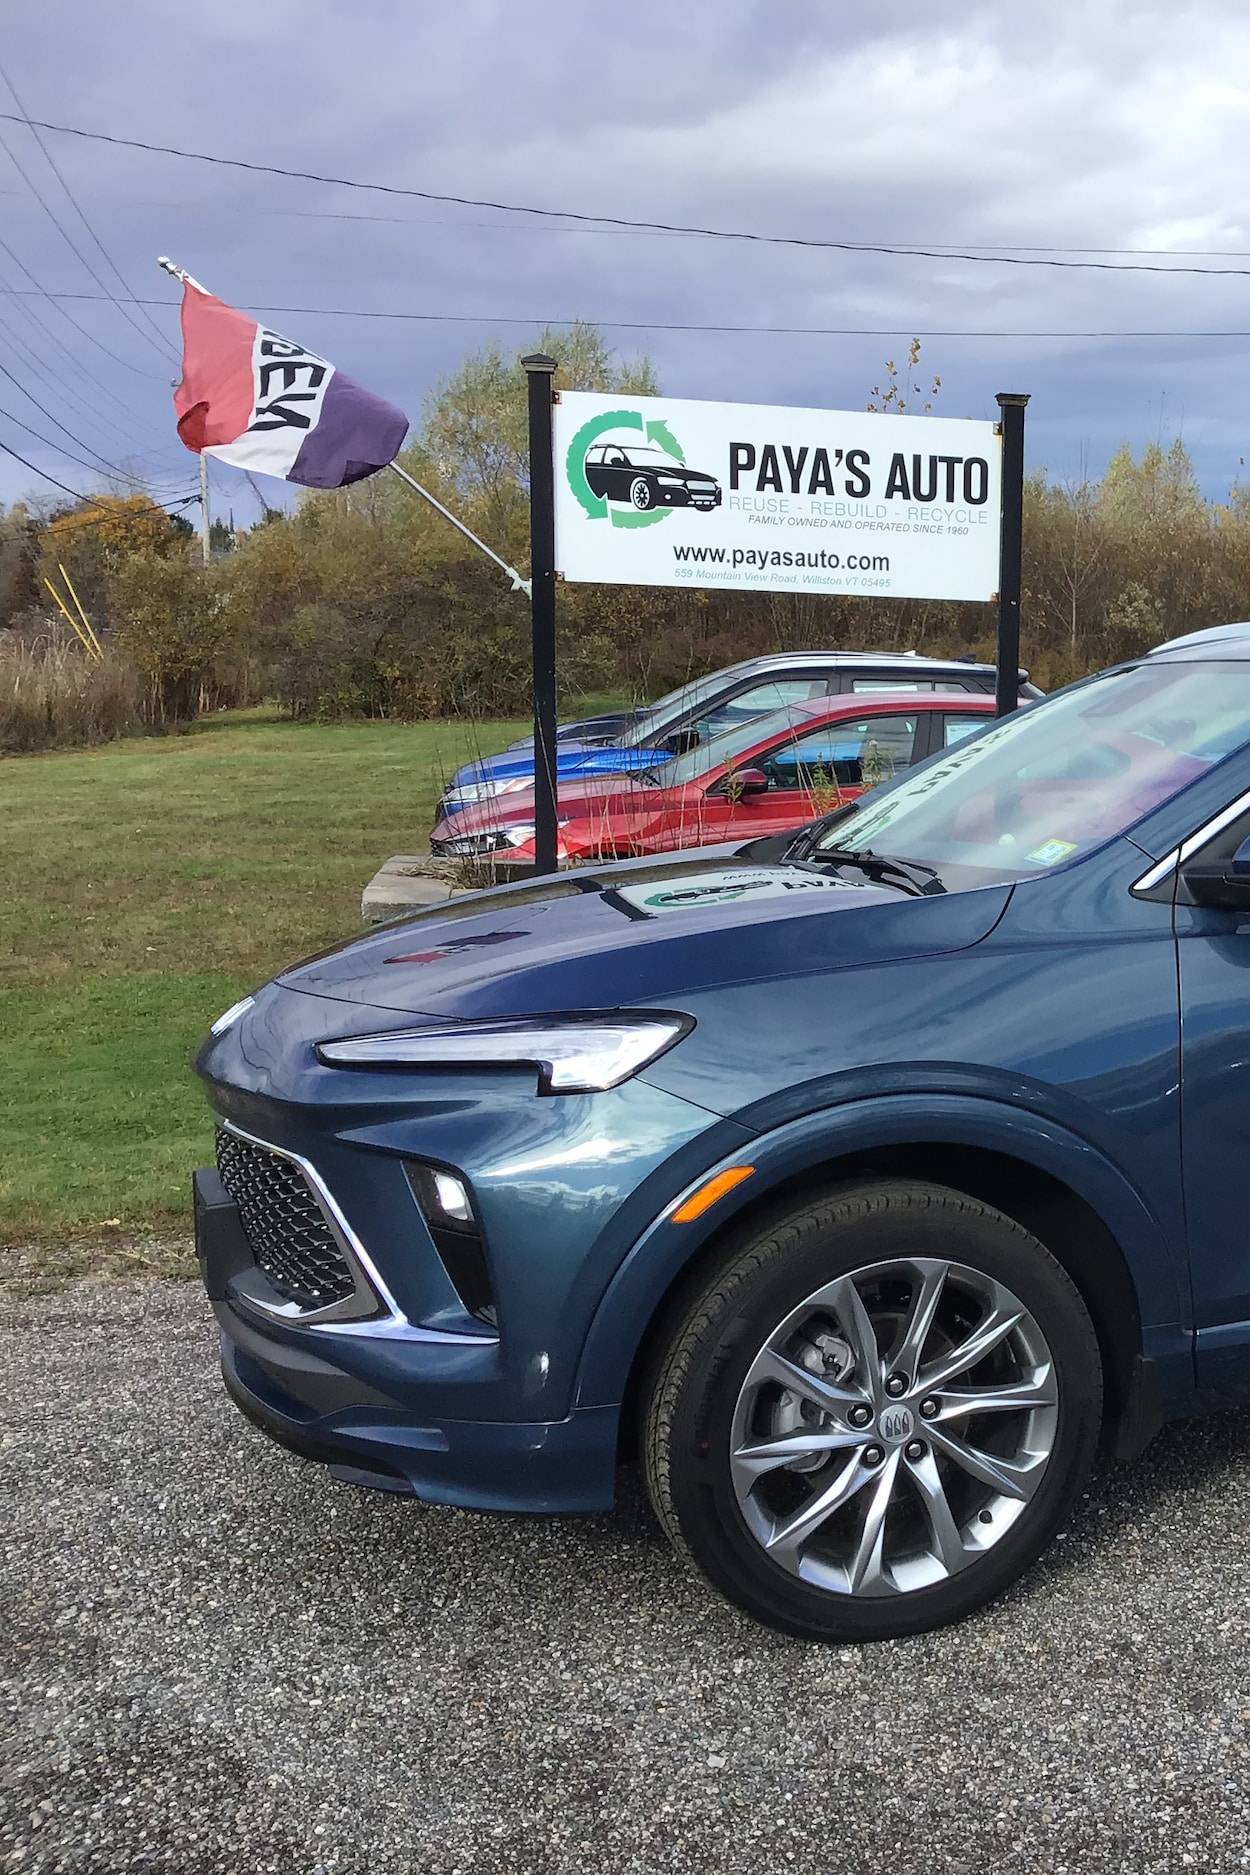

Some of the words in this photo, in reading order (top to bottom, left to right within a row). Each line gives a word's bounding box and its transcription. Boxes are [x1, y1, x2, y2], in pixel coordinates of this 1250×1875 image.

[729, 441, 871, 499] PAYA'S
[884, 452, 989, 505] AUTO
[729, 496, 790, 513] REUSE
[811, 501, 887, 518] REBUILD
[908, 506, 988, 524] RECYCLE
[748, 514, 786, 525] FAMILY
[787, 516, 828, 528] OWNED
[829, 520, 852, 529] AND
[854, 521, 910, 532] OPERATED
[912, 524, 944, 534] SINCE
[947, 526, 969, 535] 1960
[673, 545, 890, 572] www.payasauto.com
[674, 568, 693, 578] 559
[695, 569, 741, 580] Mountain
[744, 571, 768, 582] View
[770, 573, 799, 584] Road,
[802, 574, 842, 586] Williston
[845, 576, 859, 586] VT
[861, 577, 892, 588] 05495
